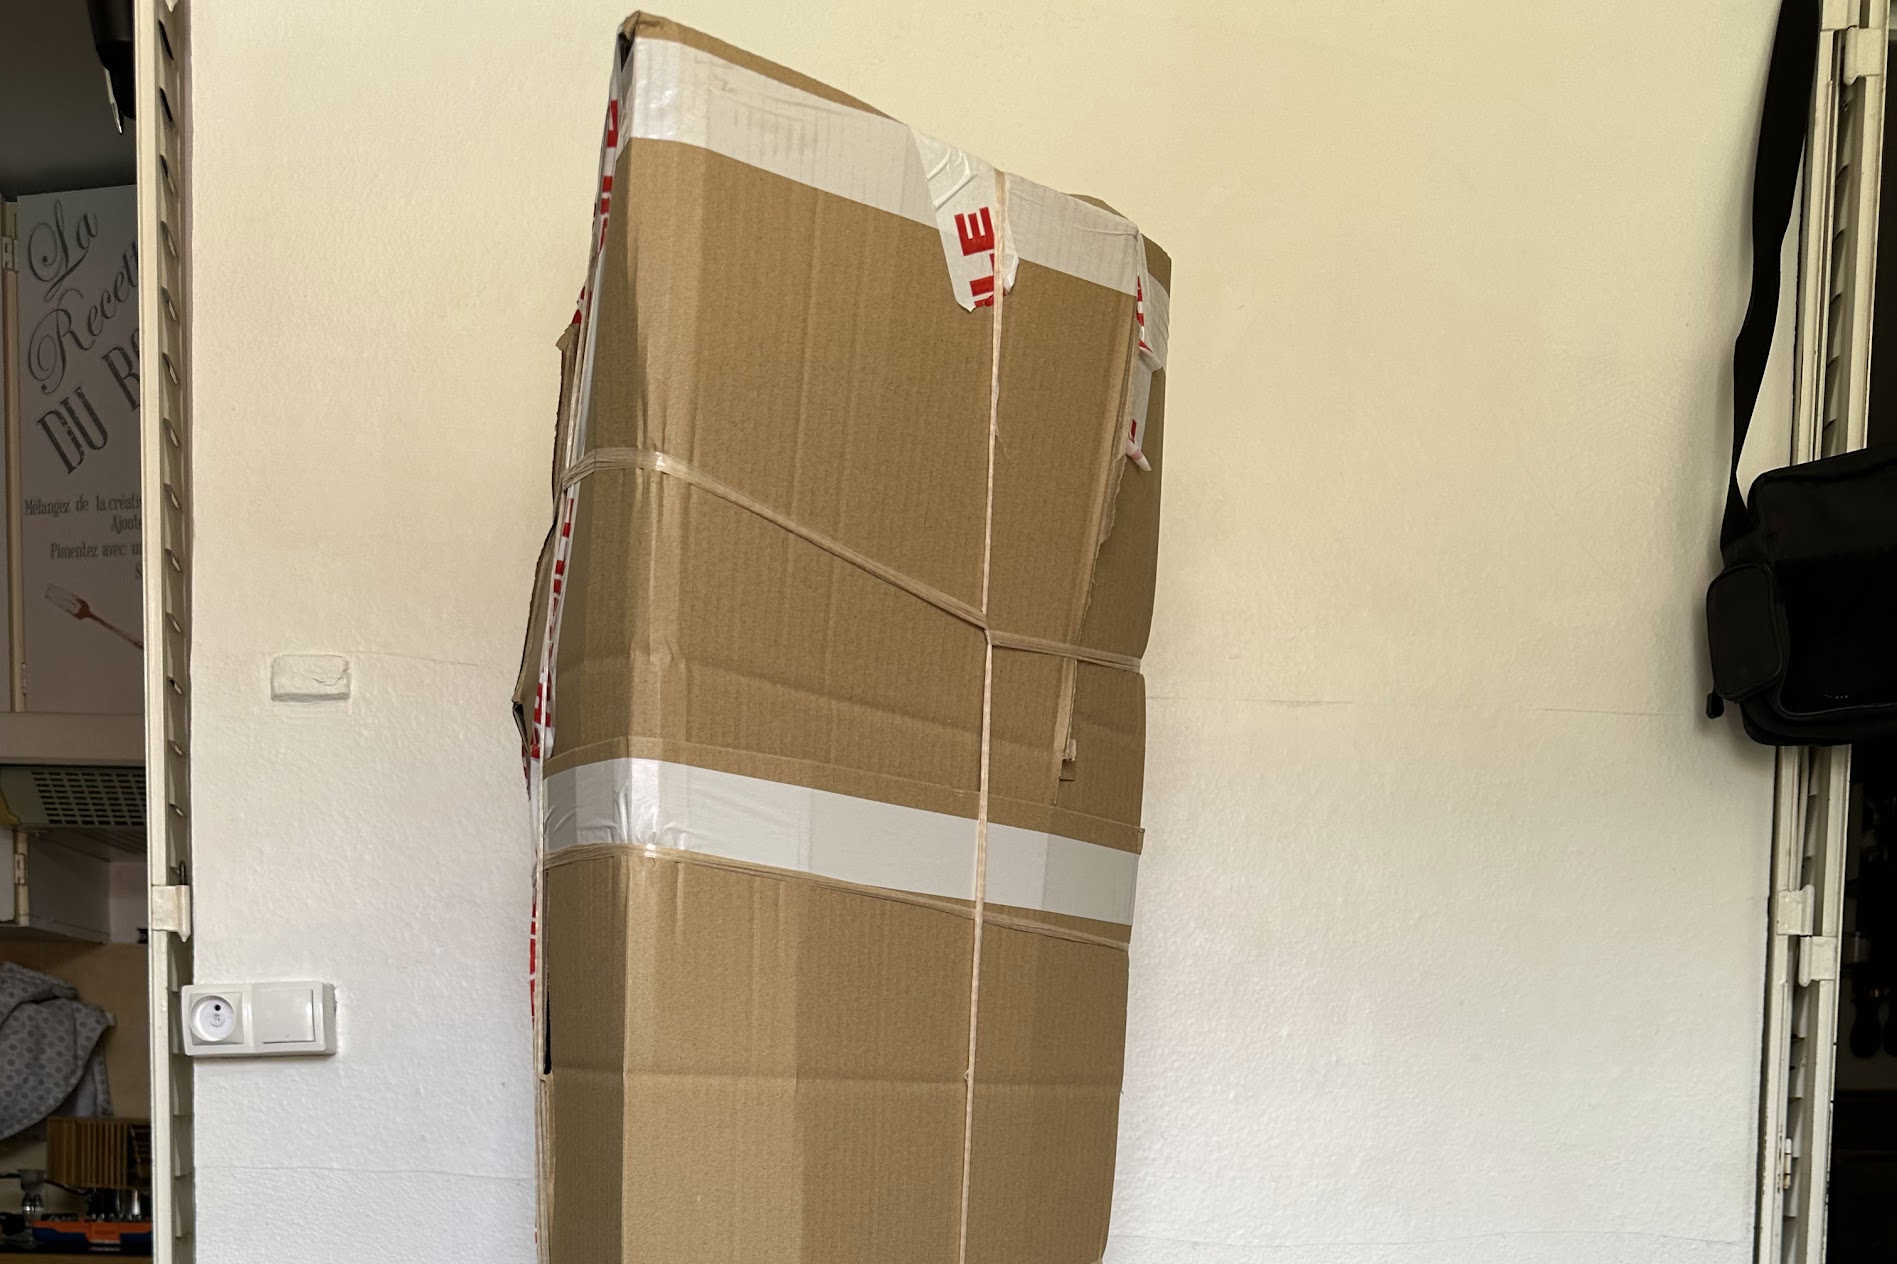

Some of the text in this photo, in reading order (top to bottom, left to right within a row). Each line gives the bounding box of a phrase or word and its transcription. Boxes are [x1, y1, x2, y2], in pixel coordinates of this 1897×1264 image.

[28, 200, 98, 303] La
[37, 386, 108, 474] DU
[76, 495, 88, 512] de
[96, 496, 107, 511] la
[50, 542, 98, 558] Pimentez
[102, 544, 126, 557] avec
